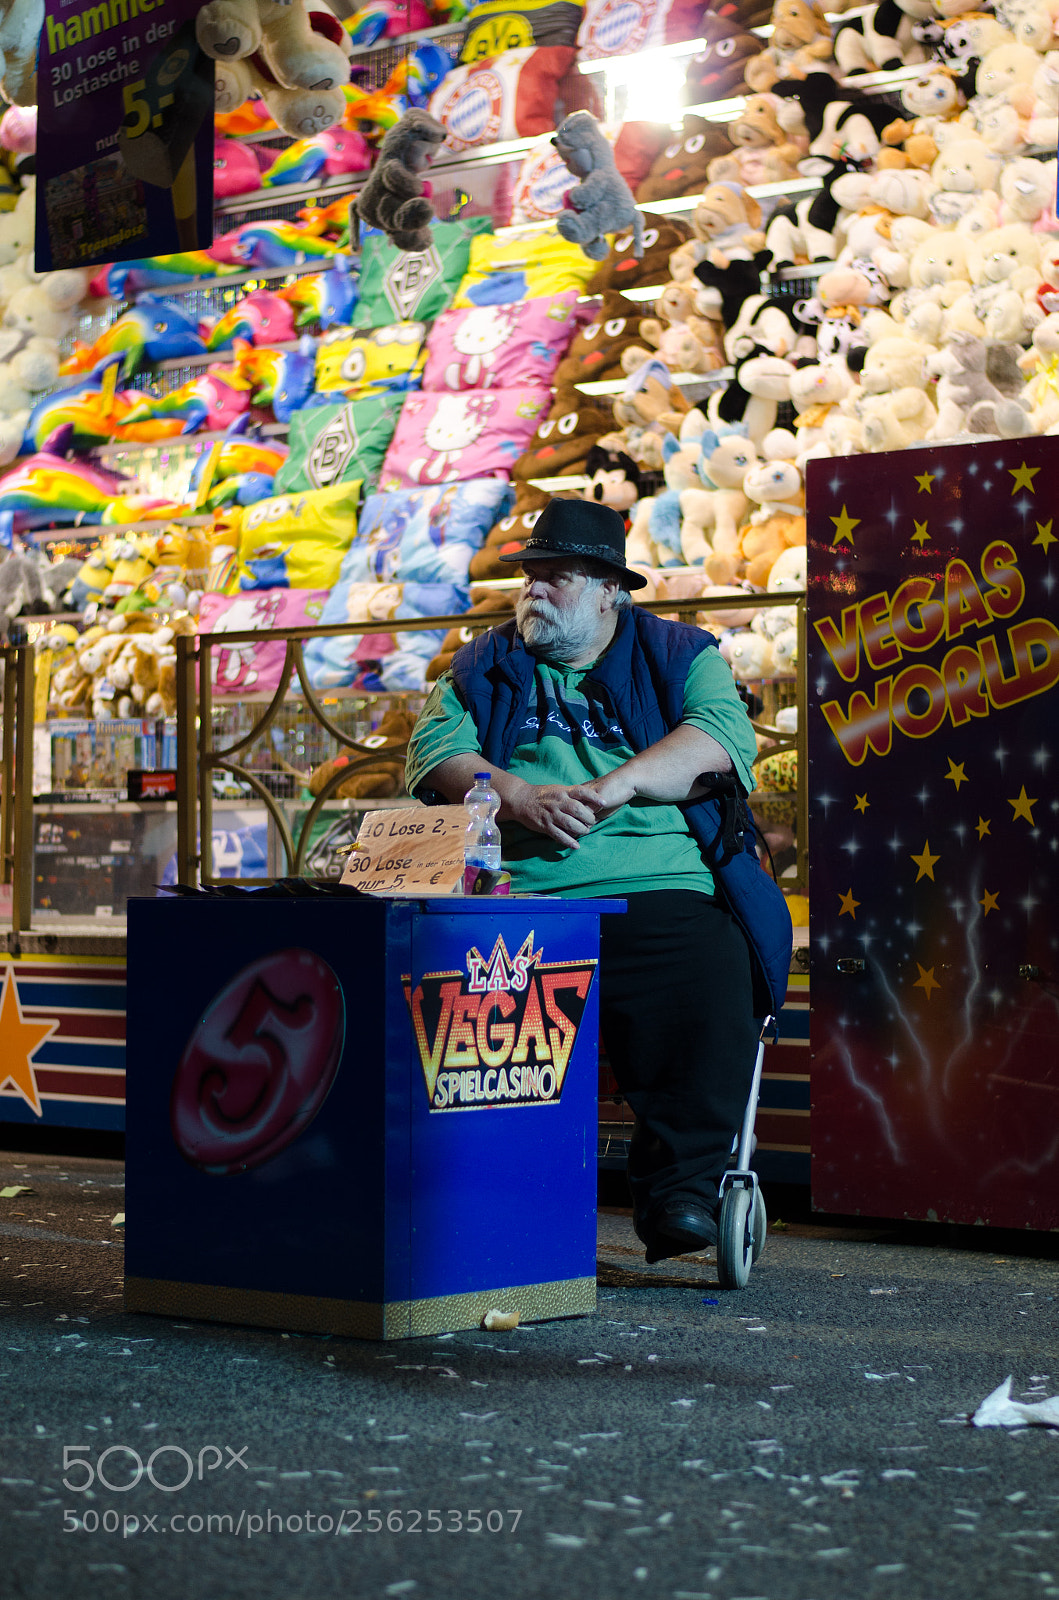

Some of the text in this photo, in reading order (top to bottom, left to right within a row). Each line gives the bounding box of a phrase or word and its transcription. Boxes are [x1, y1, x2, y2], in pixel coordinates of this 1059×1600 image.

[51, 19, 176, 86] 30 Lose in der
[53, 59, 140, 108] Lostasche
[96, 133, 122, 152] nur
[813, 540, 1025, 682] VEGAS
[820, 617, 1059, 767] WORLD
[364, 822, 384, 838] 10
[388, 821, 426, 837] Lose
[350, 856, 371, 873] 30
[375, 855, 413, 871] Lose
[425, 860, 439, 868] der
[356, 879, 385, 891] nur
[429, 871, 444, 885] €
[468, 949, 529, 992] LAS
[404, 970, 594, 1103] VEGAS
[434, 1065, 557, 1107] SPIELCASINO
